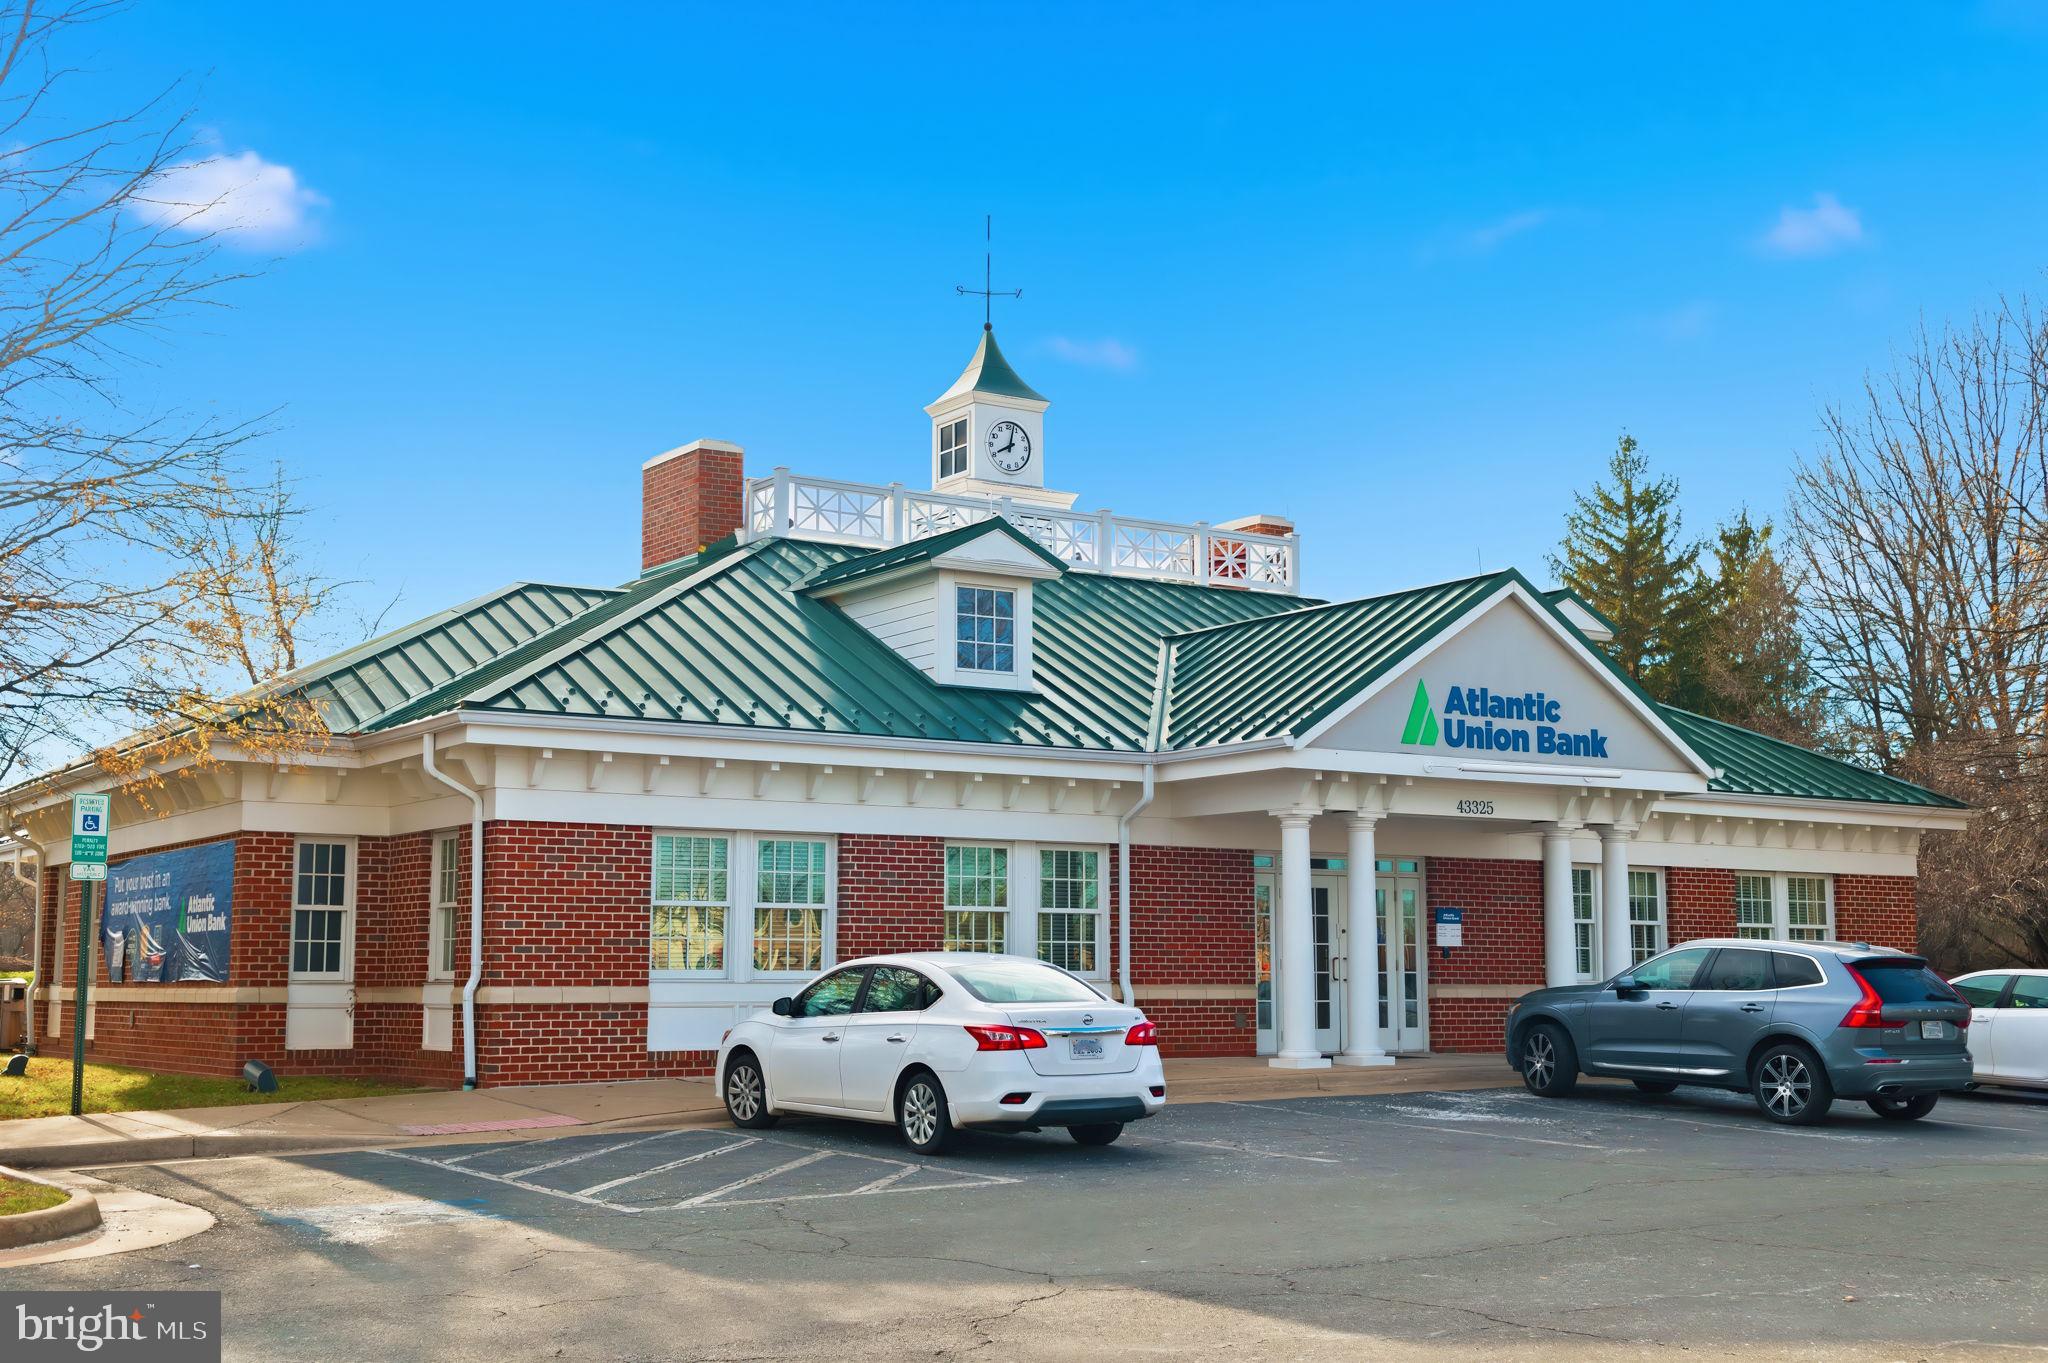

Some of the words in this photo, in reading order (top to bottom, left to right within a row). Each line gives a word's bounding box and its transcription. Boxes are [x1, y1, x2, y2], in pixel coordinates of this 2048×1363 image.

[1444, 685, 1561, 723] Atlantic
[1443, 718, 1530, 753] Union
[1536, 725, 1608, 758] Bank
[1456, 799, 1494, 815] 43325
[114, 876, 125, 893] Put
[125, 877, 139, 896] your
[139, 873, 154, 890] trust
[154, 870, 162, 887] in
[162, 871, 171, 887] an
[111, 895, 153, 916] award-winning
[187, 893, 215, 914] Atlantic
[186, 914, 208, 933] Union
[207, 911, 227, 931] Bank
